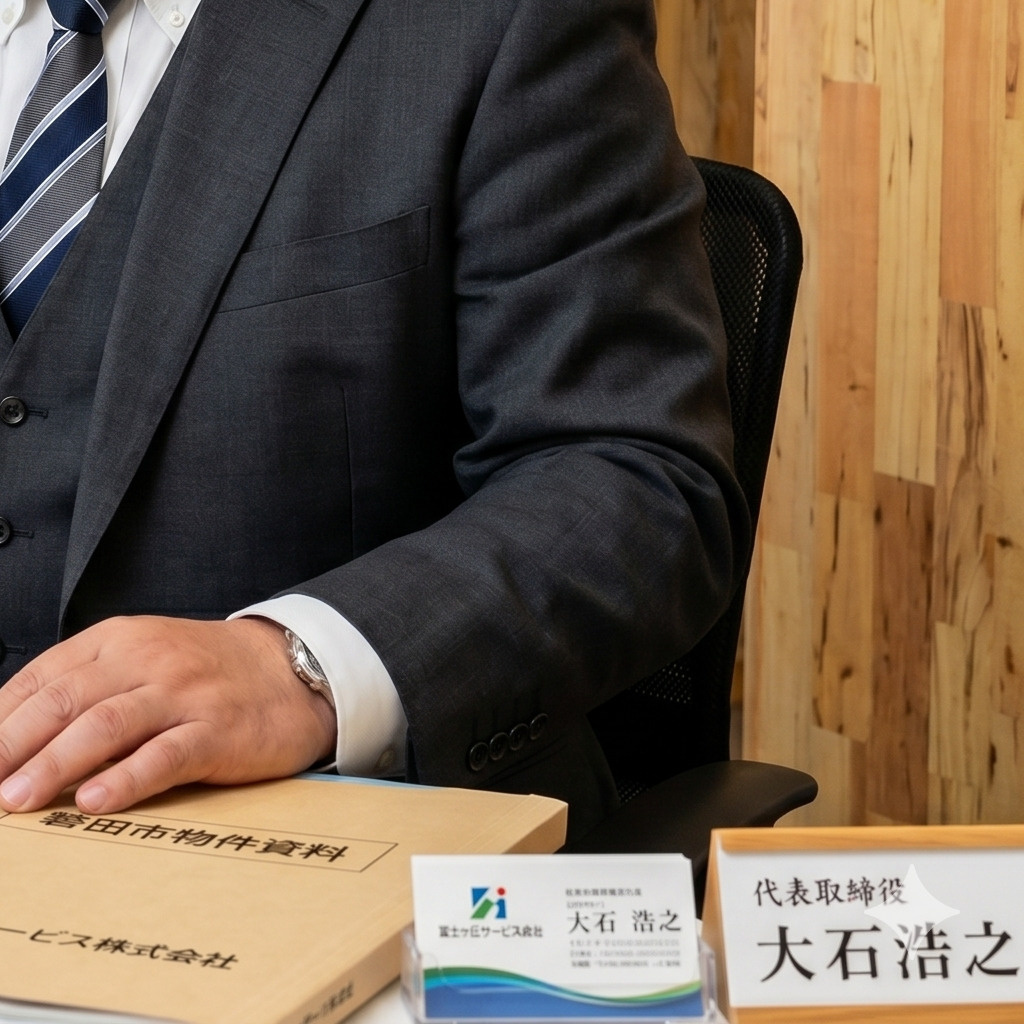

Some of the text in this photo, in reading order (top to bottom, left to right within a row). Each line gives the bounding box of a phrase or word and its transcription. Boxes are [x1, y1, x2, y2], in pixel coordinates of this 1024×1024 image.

[755, 877, 908, 907] 代表取締役
[570, 909, 681, 933] 大石 浩之
[758, 921, 1019, 982] 大石浩之
